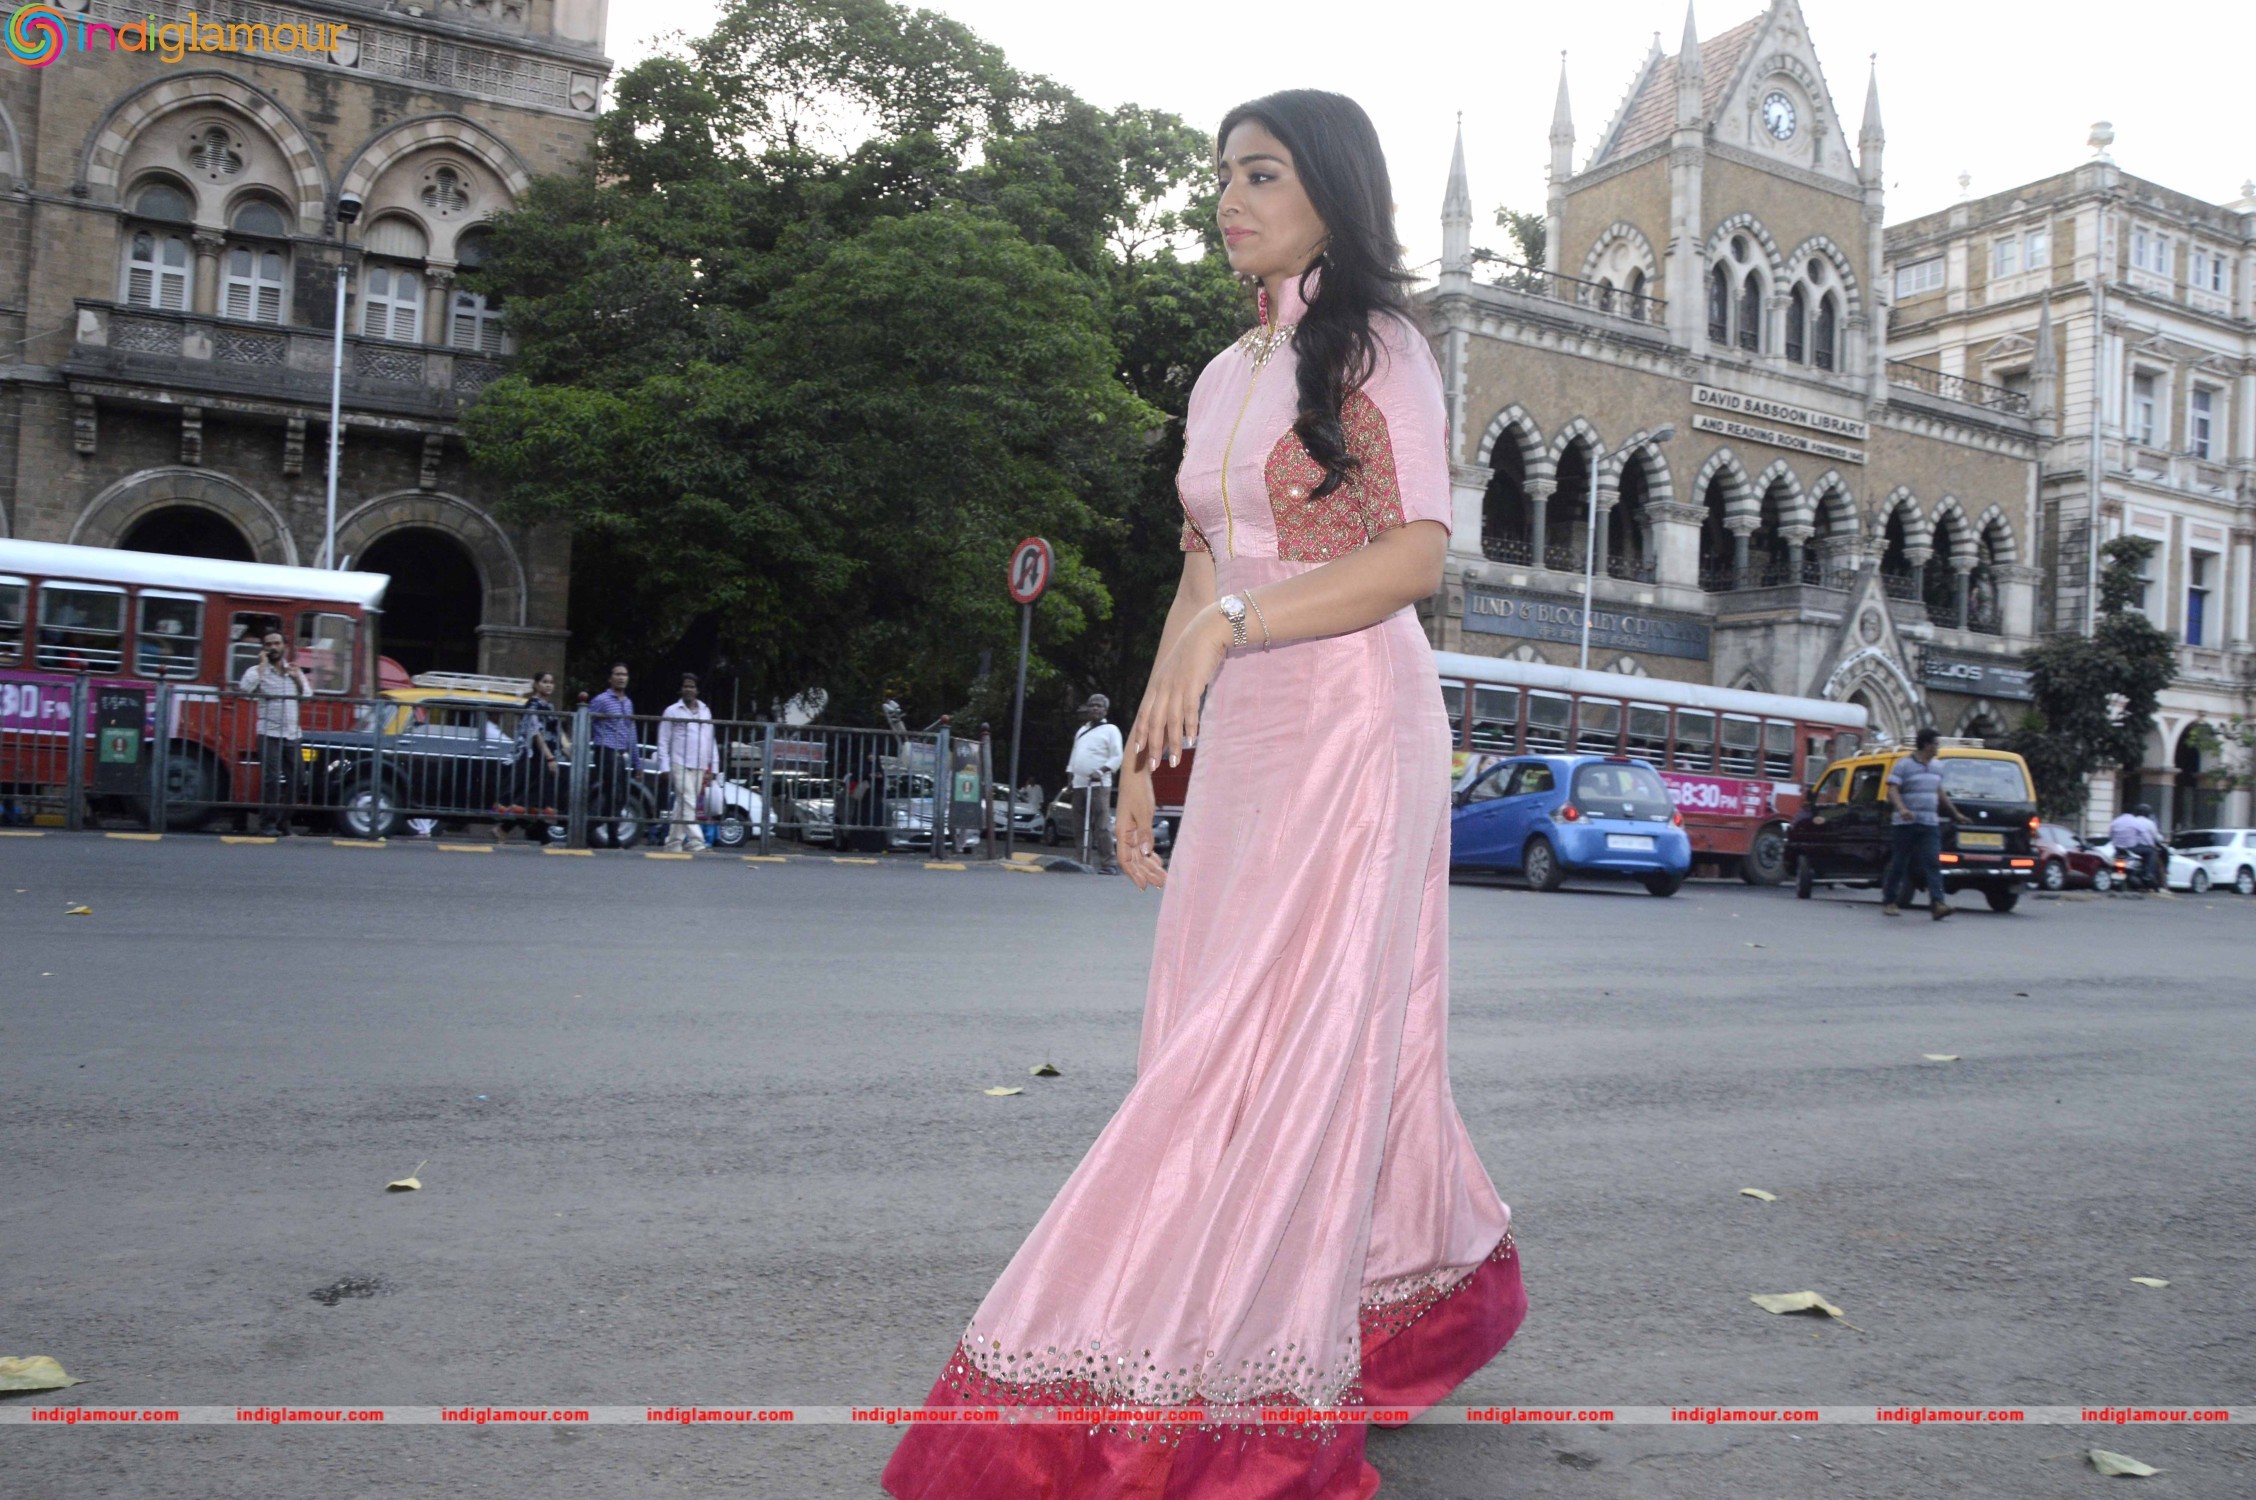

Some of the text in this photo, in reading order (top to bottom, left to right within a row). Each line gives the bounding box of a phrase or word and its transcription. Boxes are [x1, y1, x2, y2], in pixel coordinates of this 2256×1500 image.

[1699, 389, 1865, 437] DAVID SASSOON LIBRARY
[1701, 417, 1724, 432] AND
[1727, 422, 1775, 442] READING
[1777, 433, 1808, 450] ROOM
[1472, 595, 1514, 617] LUND
[1518, 601, 1532, 620] &
[1536, 604, 1619, 632] BLOCLEY
[1681, 781, 1721, 809] 8:30
[1720, 795, 1738, 809] PM
